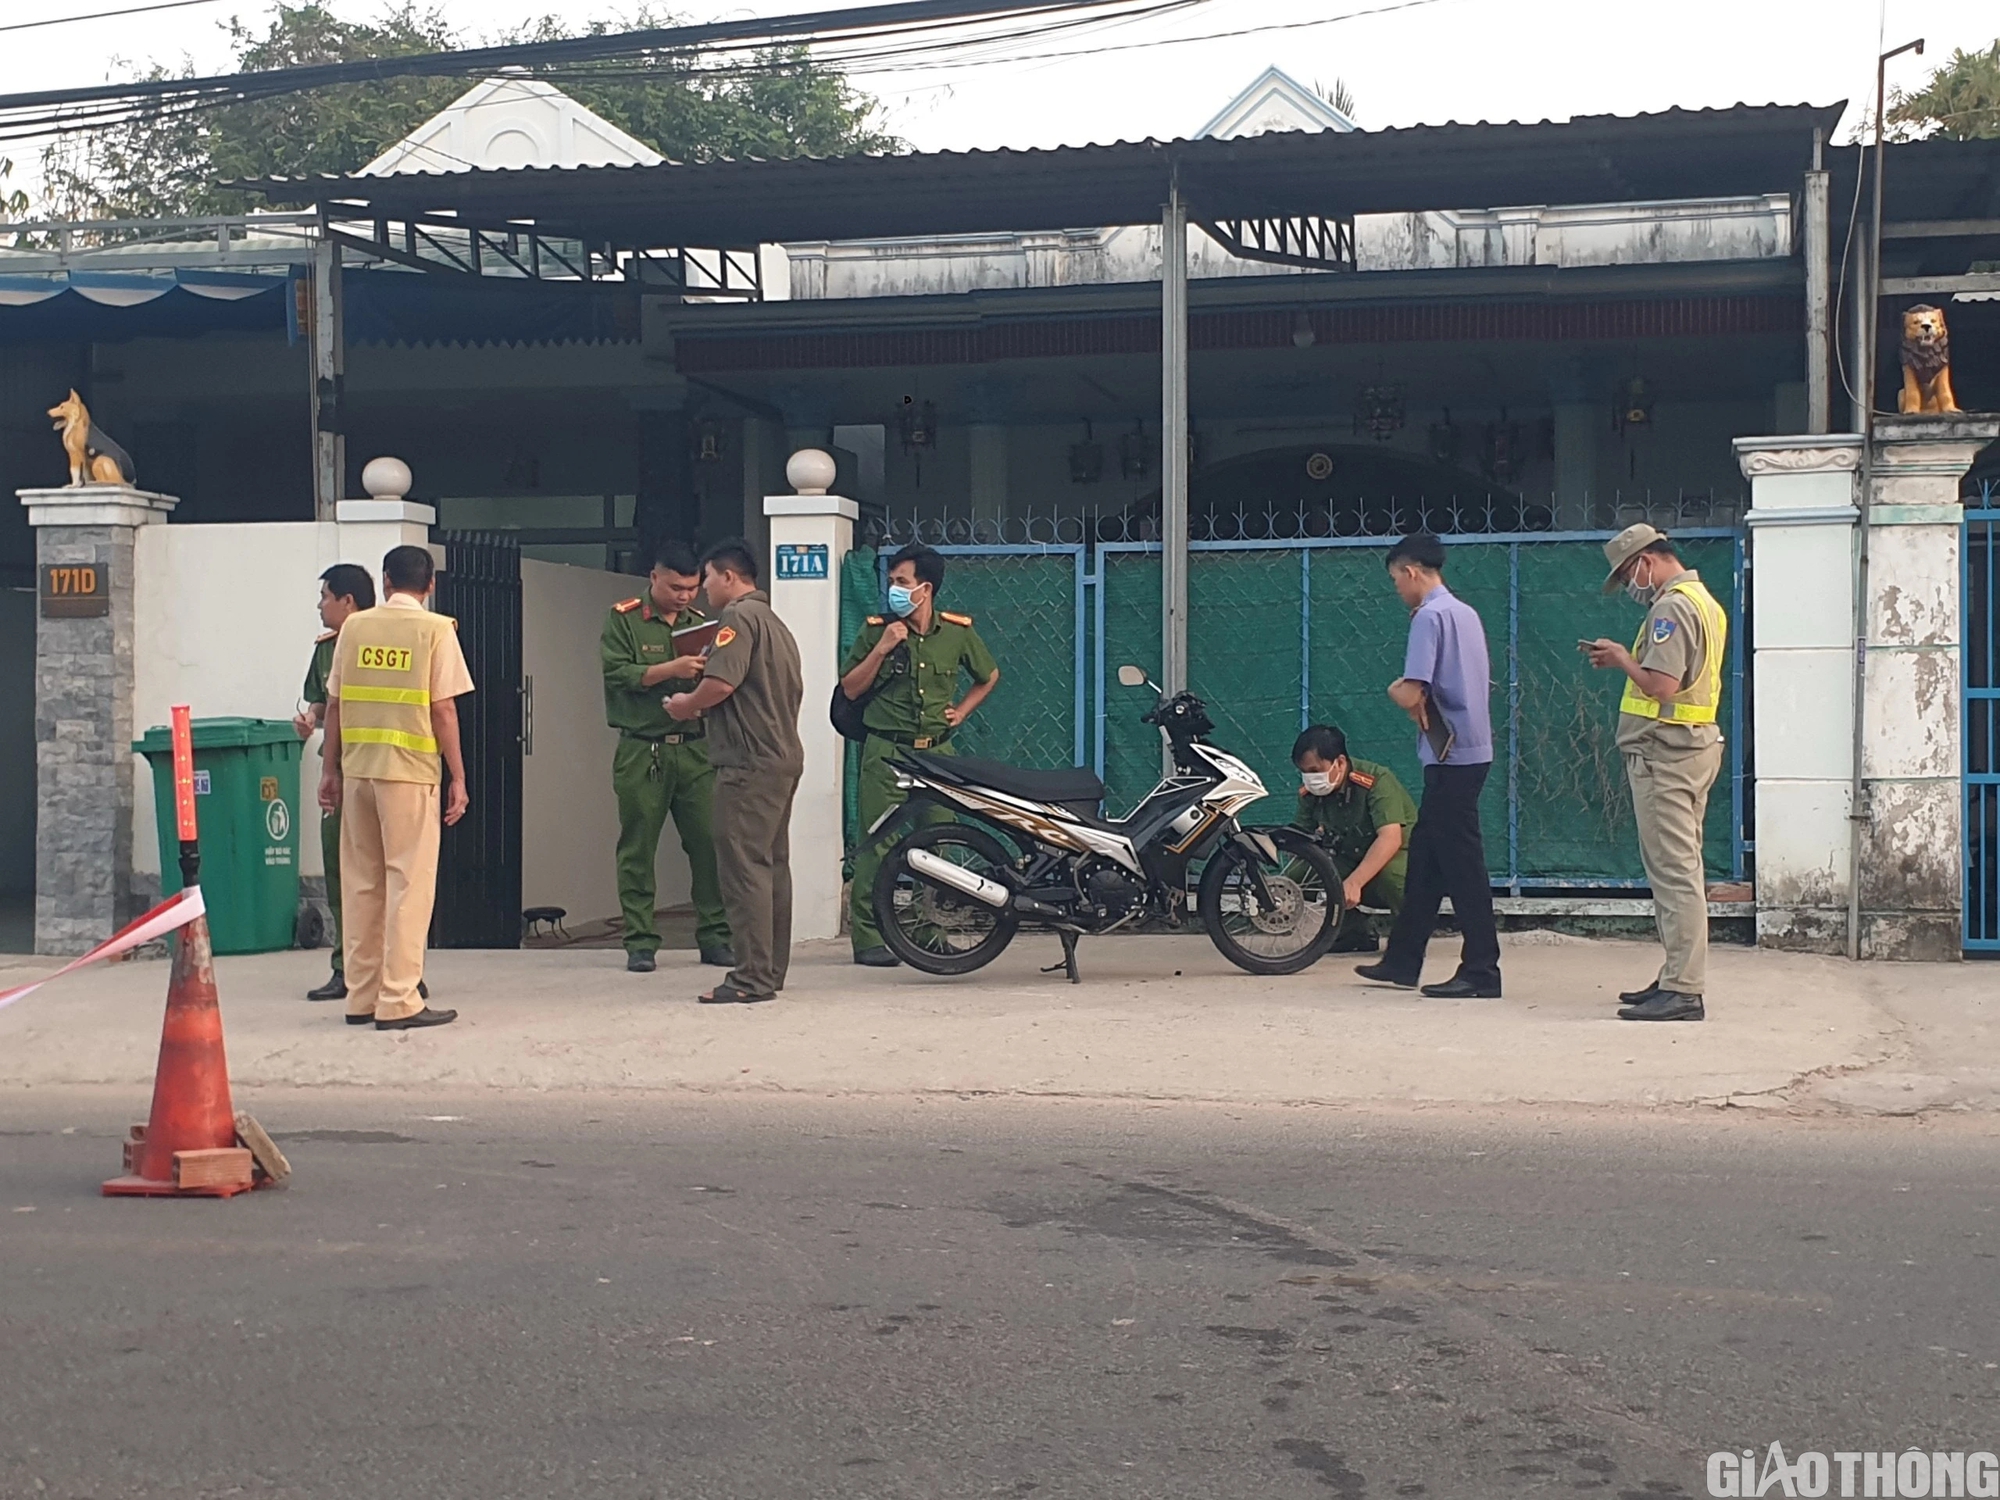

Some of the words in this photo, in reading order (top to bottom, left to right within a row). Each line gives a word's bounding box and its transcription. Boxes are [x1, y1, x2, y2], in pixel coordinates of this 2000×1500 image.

[781, 554, 824, 573] 171A
[50, 568, 96, 594] 171D
[362, 647, 410, 669] CSGT
